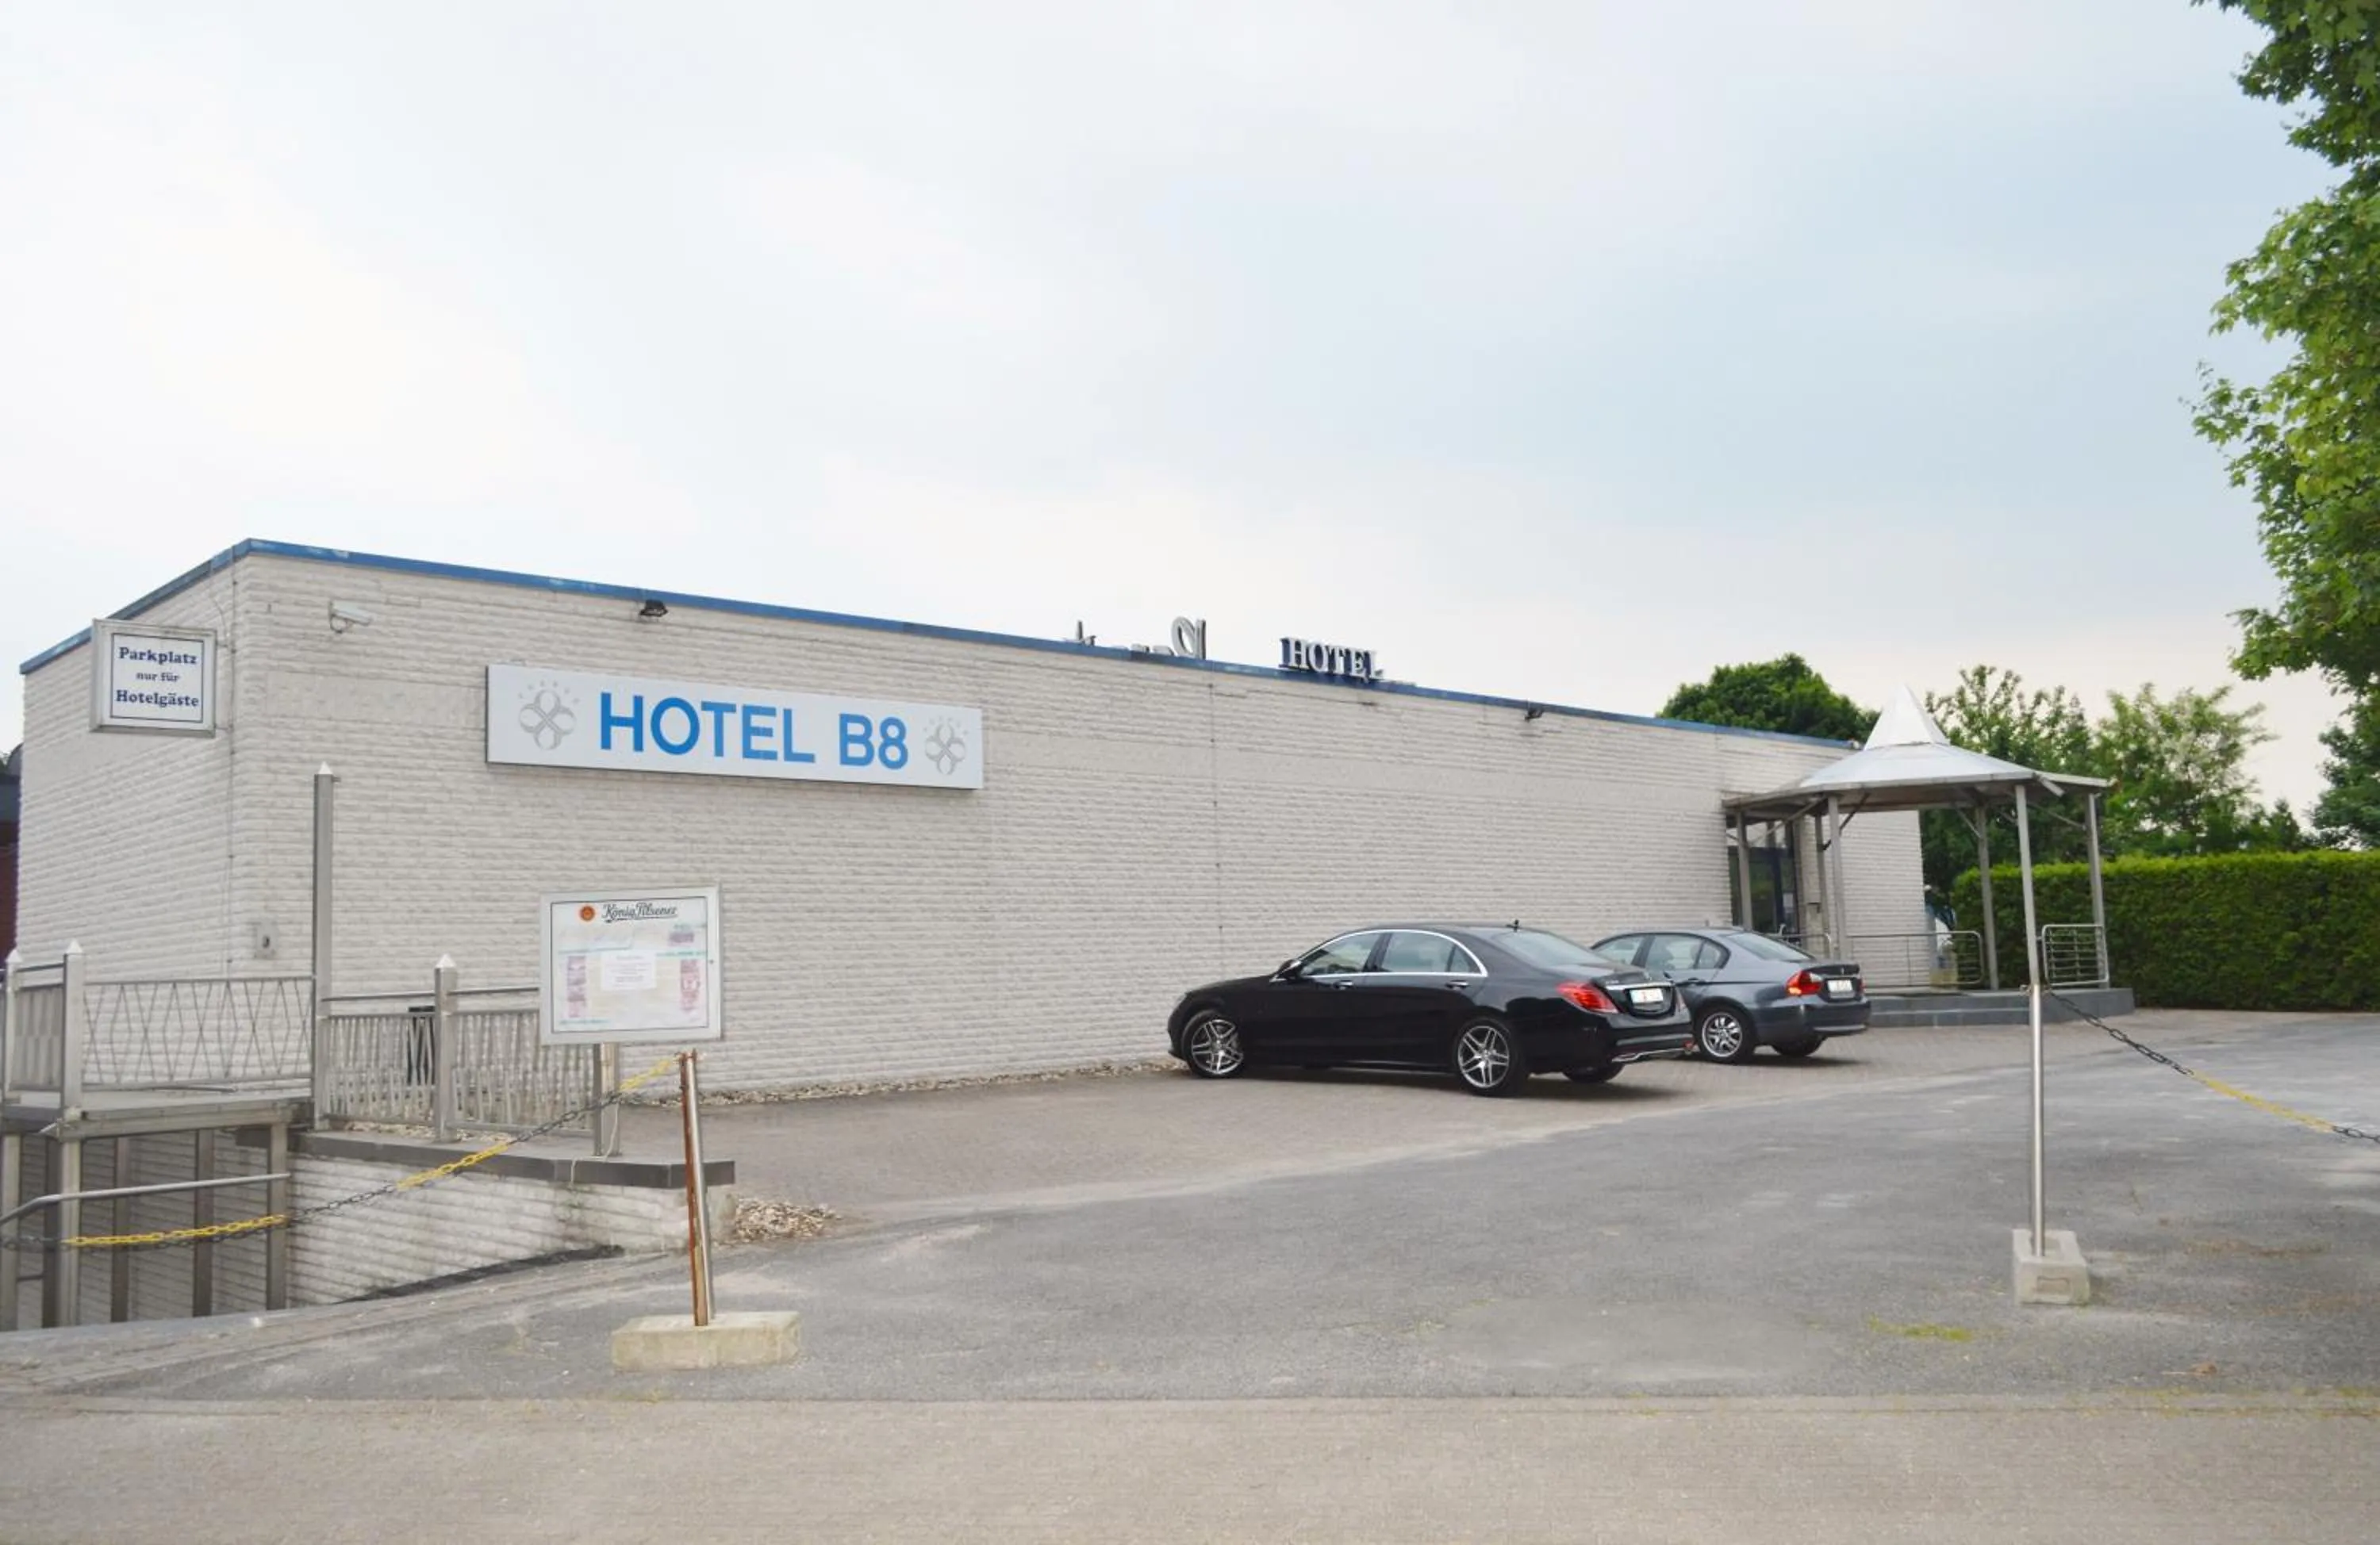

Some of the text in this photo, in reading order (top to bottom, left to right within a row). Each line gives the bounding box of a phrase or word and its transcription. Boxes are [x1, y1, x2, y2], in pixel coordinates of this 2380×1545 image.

[119, 647, 197, 665] Parkplatz
[1279, 637, 1384, 680] HOTEL
[136, 672, 180, 682] nur für
[116, 690, 199, 707] Hotelgäste
[600, 692, 909, 770] HOTEL B8
